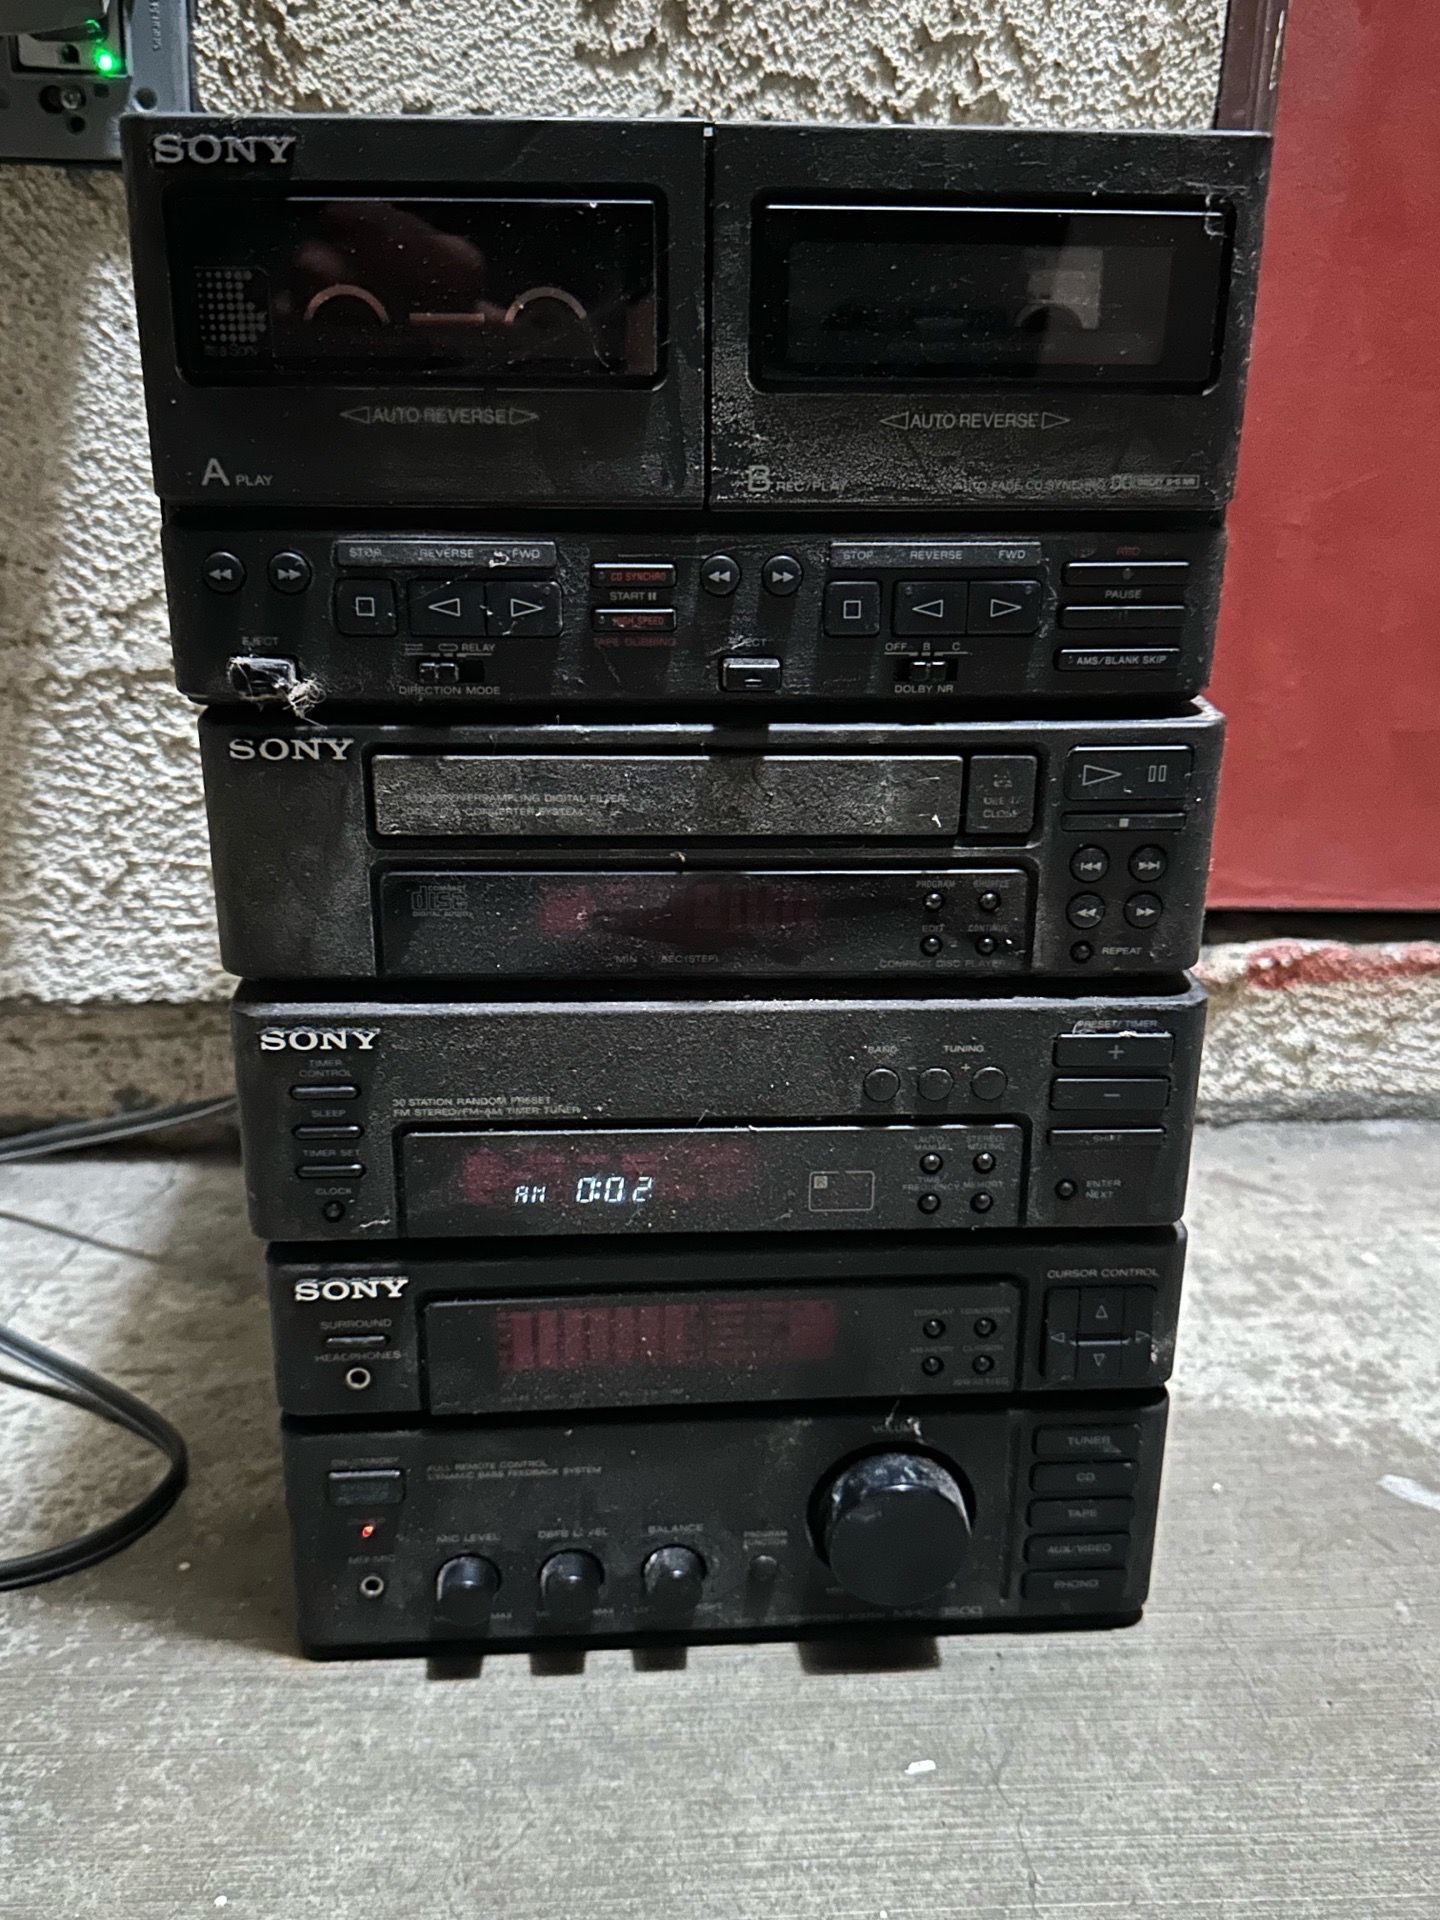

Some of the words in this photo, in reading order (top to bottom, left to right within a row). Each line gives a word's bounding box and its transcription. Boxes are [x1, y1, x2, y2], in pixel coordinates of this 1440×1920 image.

[154, 134, 297, 163] SONY
[372, 407, 419, 424] AUTO
[424, 407, 506, 424] REVERSE
[911, 413, 956, 429] AUTO
[959, 413, 1039, 429] REVERSE
[201, 457, 230, 486] A
[235, 474, 273, 486] PLAY
[748, 465, 769, 492] B
[419, 549, 474, 559] REVERSE
[512, 549, 541, 559] FWD
[843, 551, 873, 560] STOP
[910, 551, 962, 560] REVERSE
[998, 550, 1026, 559] FWD
[609, 592, 646, 601] START
[1105, 589, 1142, 599] PAUSE
[461, 643, 496, 652] RELAY
[885, 643, 908, 652] OFF
[923, 642, 931, 651] B
[951, 641, 960, 651] C
[1077, 656, 1138, 666] AMS/BLANK
[1142, 655, 1167, 665] SKIP
[399, 686, 461, 696] DIRECTION
[465, 686, 501, 696] MODE
[894, 684, 932, 694] DOLBY
[937, 684, 954, 694] NR
[229, 738, 354, 761] SONY
[1101, 946, 1142, 955] REPEAT
[935, 960, 960, 968] DISC
[259, 1028, 381, 1051] SONY
[943, 1045, 985, 1053] TUNING
[309, 1059, 342, 1067] TIMER
[300, 1069, 352, 1077] CONTROL
[408, 1098, 452, 1106] STATION
[457, 1097, 507, 1105] RANDOM
[312, 1109, 346, 1118] SLEEP
[393, 1109, 411, 1117] FM
[507, 1106, 540, 1115] TIMER
[303, 1149, 336, 1157] TIMER
[340, 1149, 360, 1157] SET
[315, 1187, 351, 1196] CLOCK
[515, 1185, 546, 1203] AM
[1047, 1268, 1098, 1279] CURSOR
[1100, 1267, 1159, 1278] CONTROL
[294, 1276, 409, 1301] SONY
[320, 1318, 392, 1329] SURROUND
[314, 1351, 401, 1361] HEADPHONES
[1068, 1435, 1110, 1445] TUNER
[1076, 1472, 1095, 1482] CD
[1068, 1509, 1097, 1518] TAPE
[463, 1533, 498, 1542] LEVEL
[1053, 1579, 1099, 1589] PHONO
